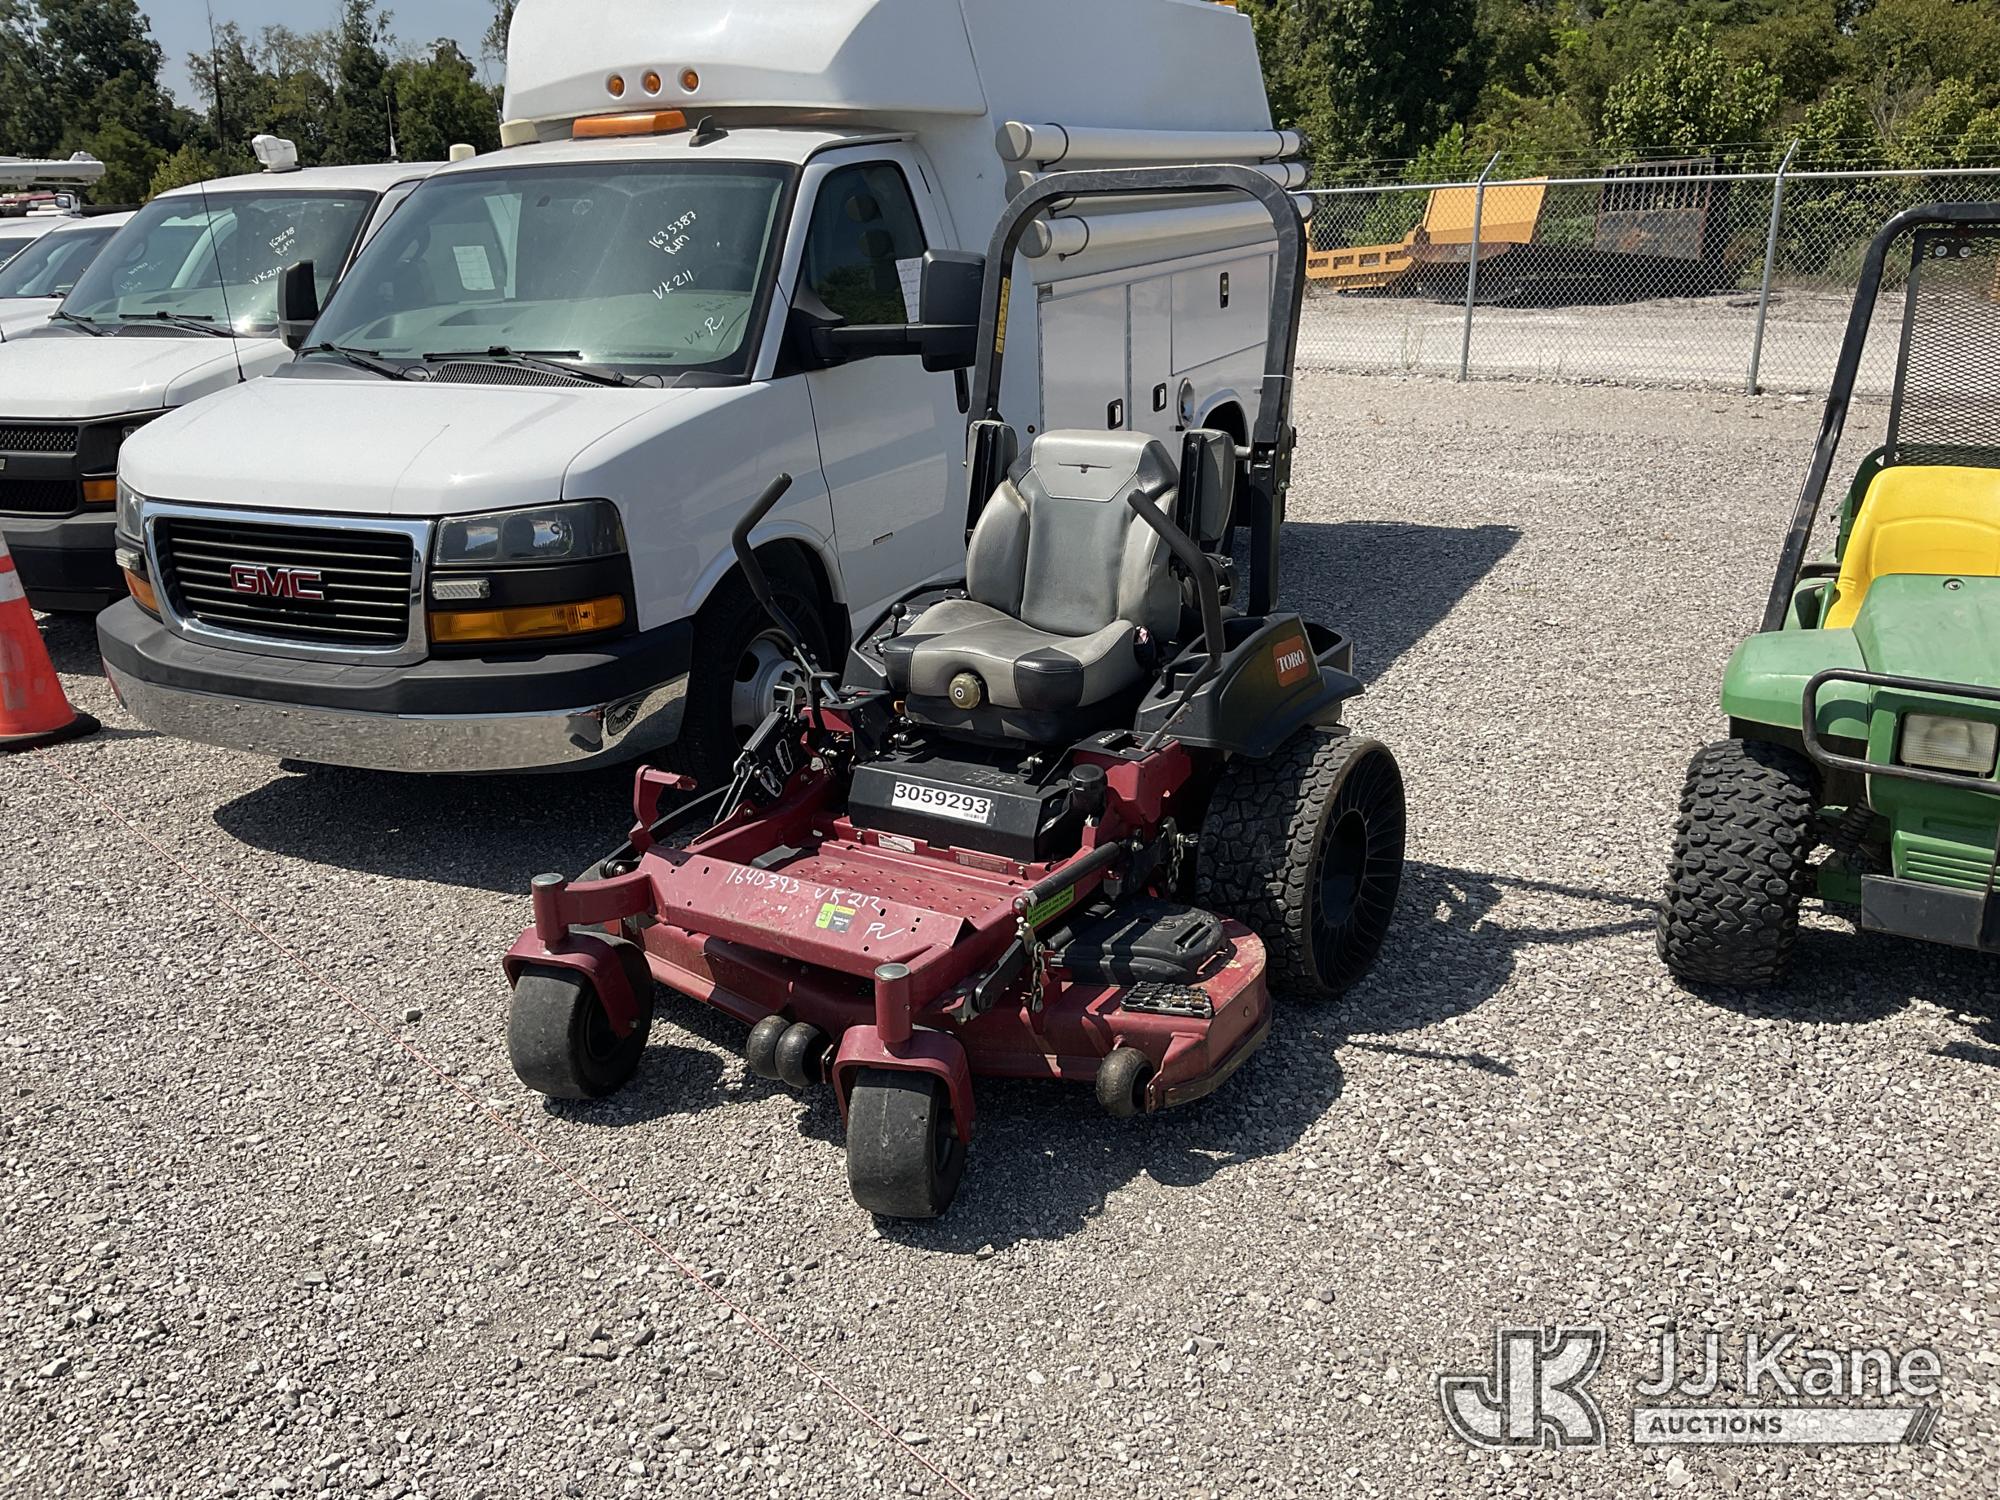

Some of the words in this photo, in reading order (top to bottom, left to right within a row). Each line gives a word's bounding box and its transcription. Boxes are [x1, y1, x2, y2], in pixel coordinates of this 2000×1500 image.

[649, 210, 697, 249] 1635387
[230, 564, 325, 601] GMC
[1276, 649, 1306, 674] TORO
[894, 783, 989, 815] 3059293
[726, 867, 800, 894] 1640393
